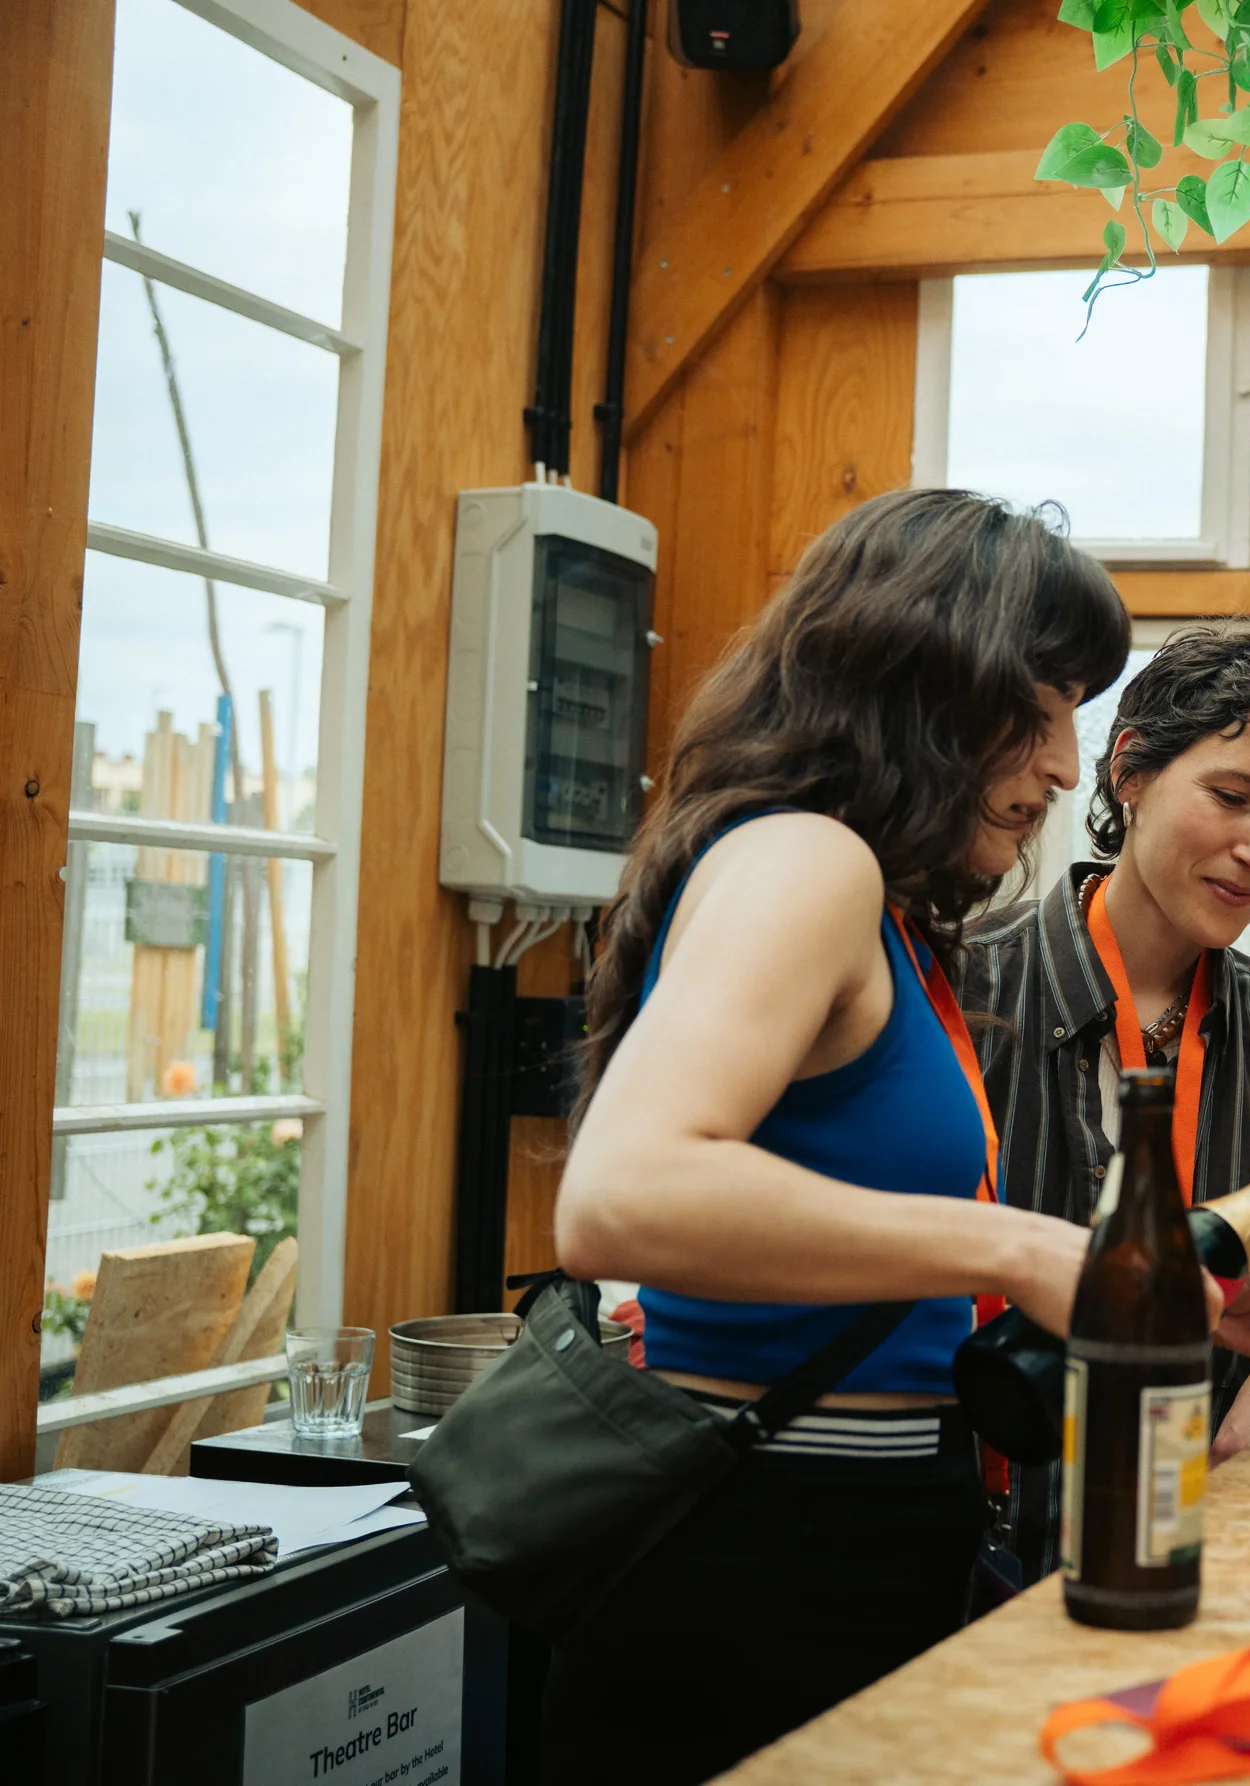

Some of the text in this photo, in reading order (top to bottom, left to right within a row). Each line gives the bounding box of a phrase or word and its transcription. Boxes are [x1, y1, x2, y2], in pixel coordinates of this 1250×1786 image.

[309, 1706, 418, 1778] Theatre Bar
[385, 1768, 400, 1784] bar
[400, 1761, 411, 1776] by
[411, 1755, 424, 1769] the
[424, 1740, 444, 1761] Hotel
